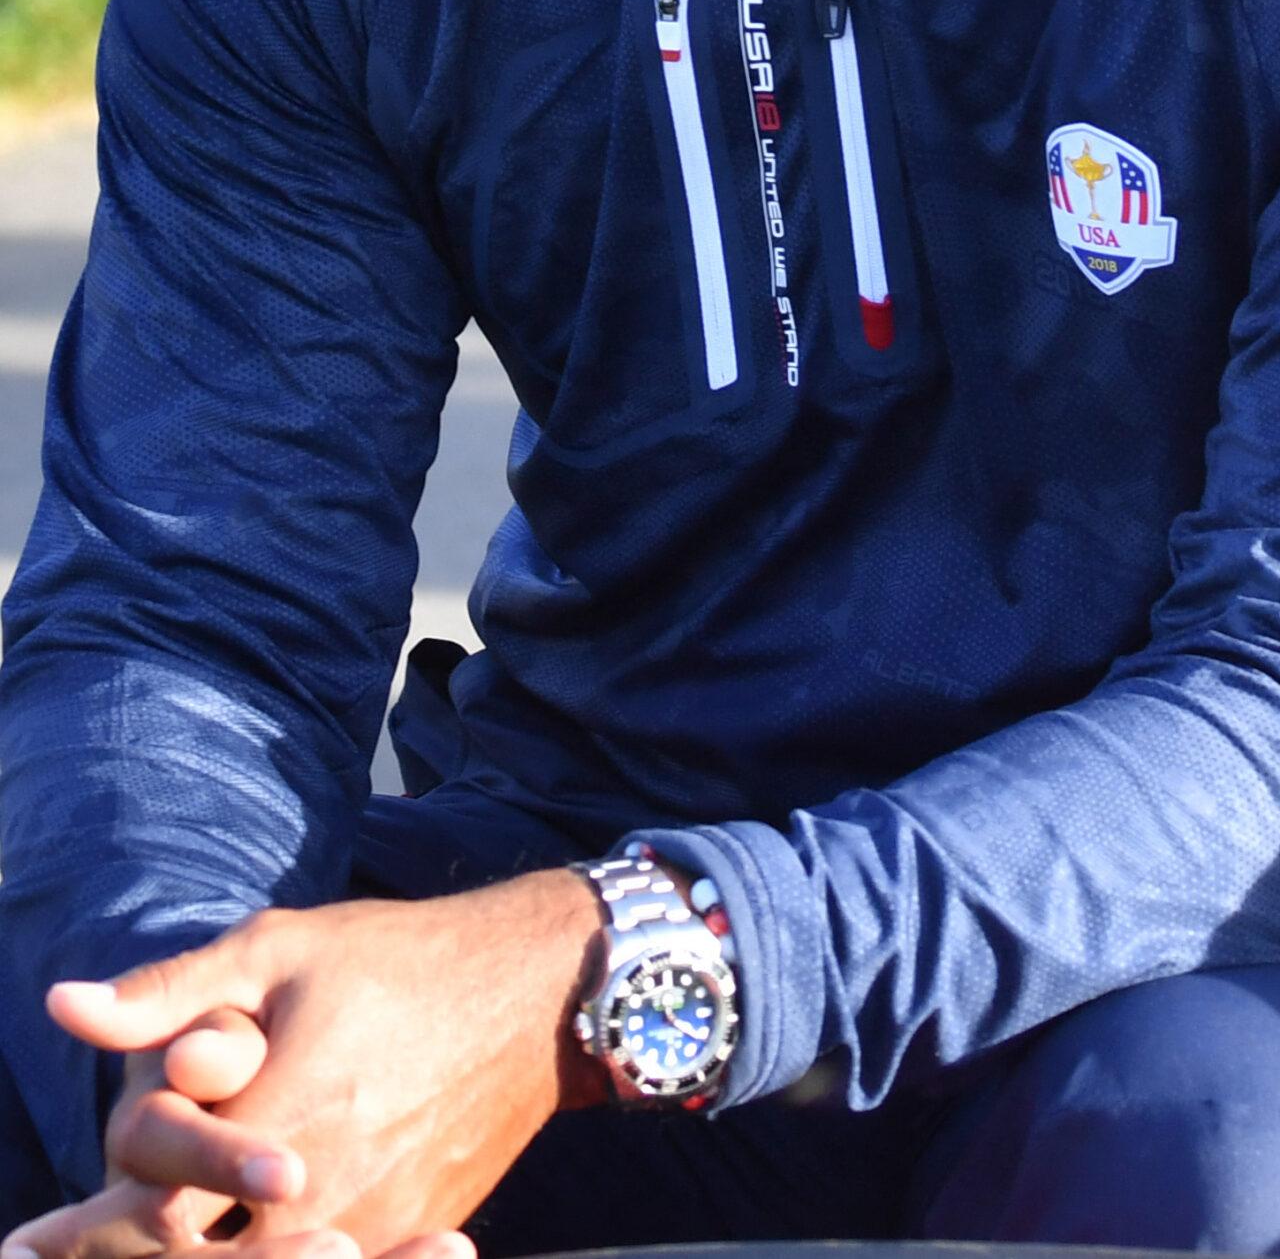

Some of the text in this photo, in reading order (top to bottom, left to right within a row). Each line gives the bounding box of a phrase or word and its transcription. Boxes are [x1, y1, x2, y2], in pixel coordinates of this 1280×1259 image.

[761, 138, 785, 238] UNITED
[1078, 224, 1121, 247] USA
[774, 247, 787, 288] WE
[1088, 257, 1118, 273] 2018
[777, 296, 799, 387] STAND
